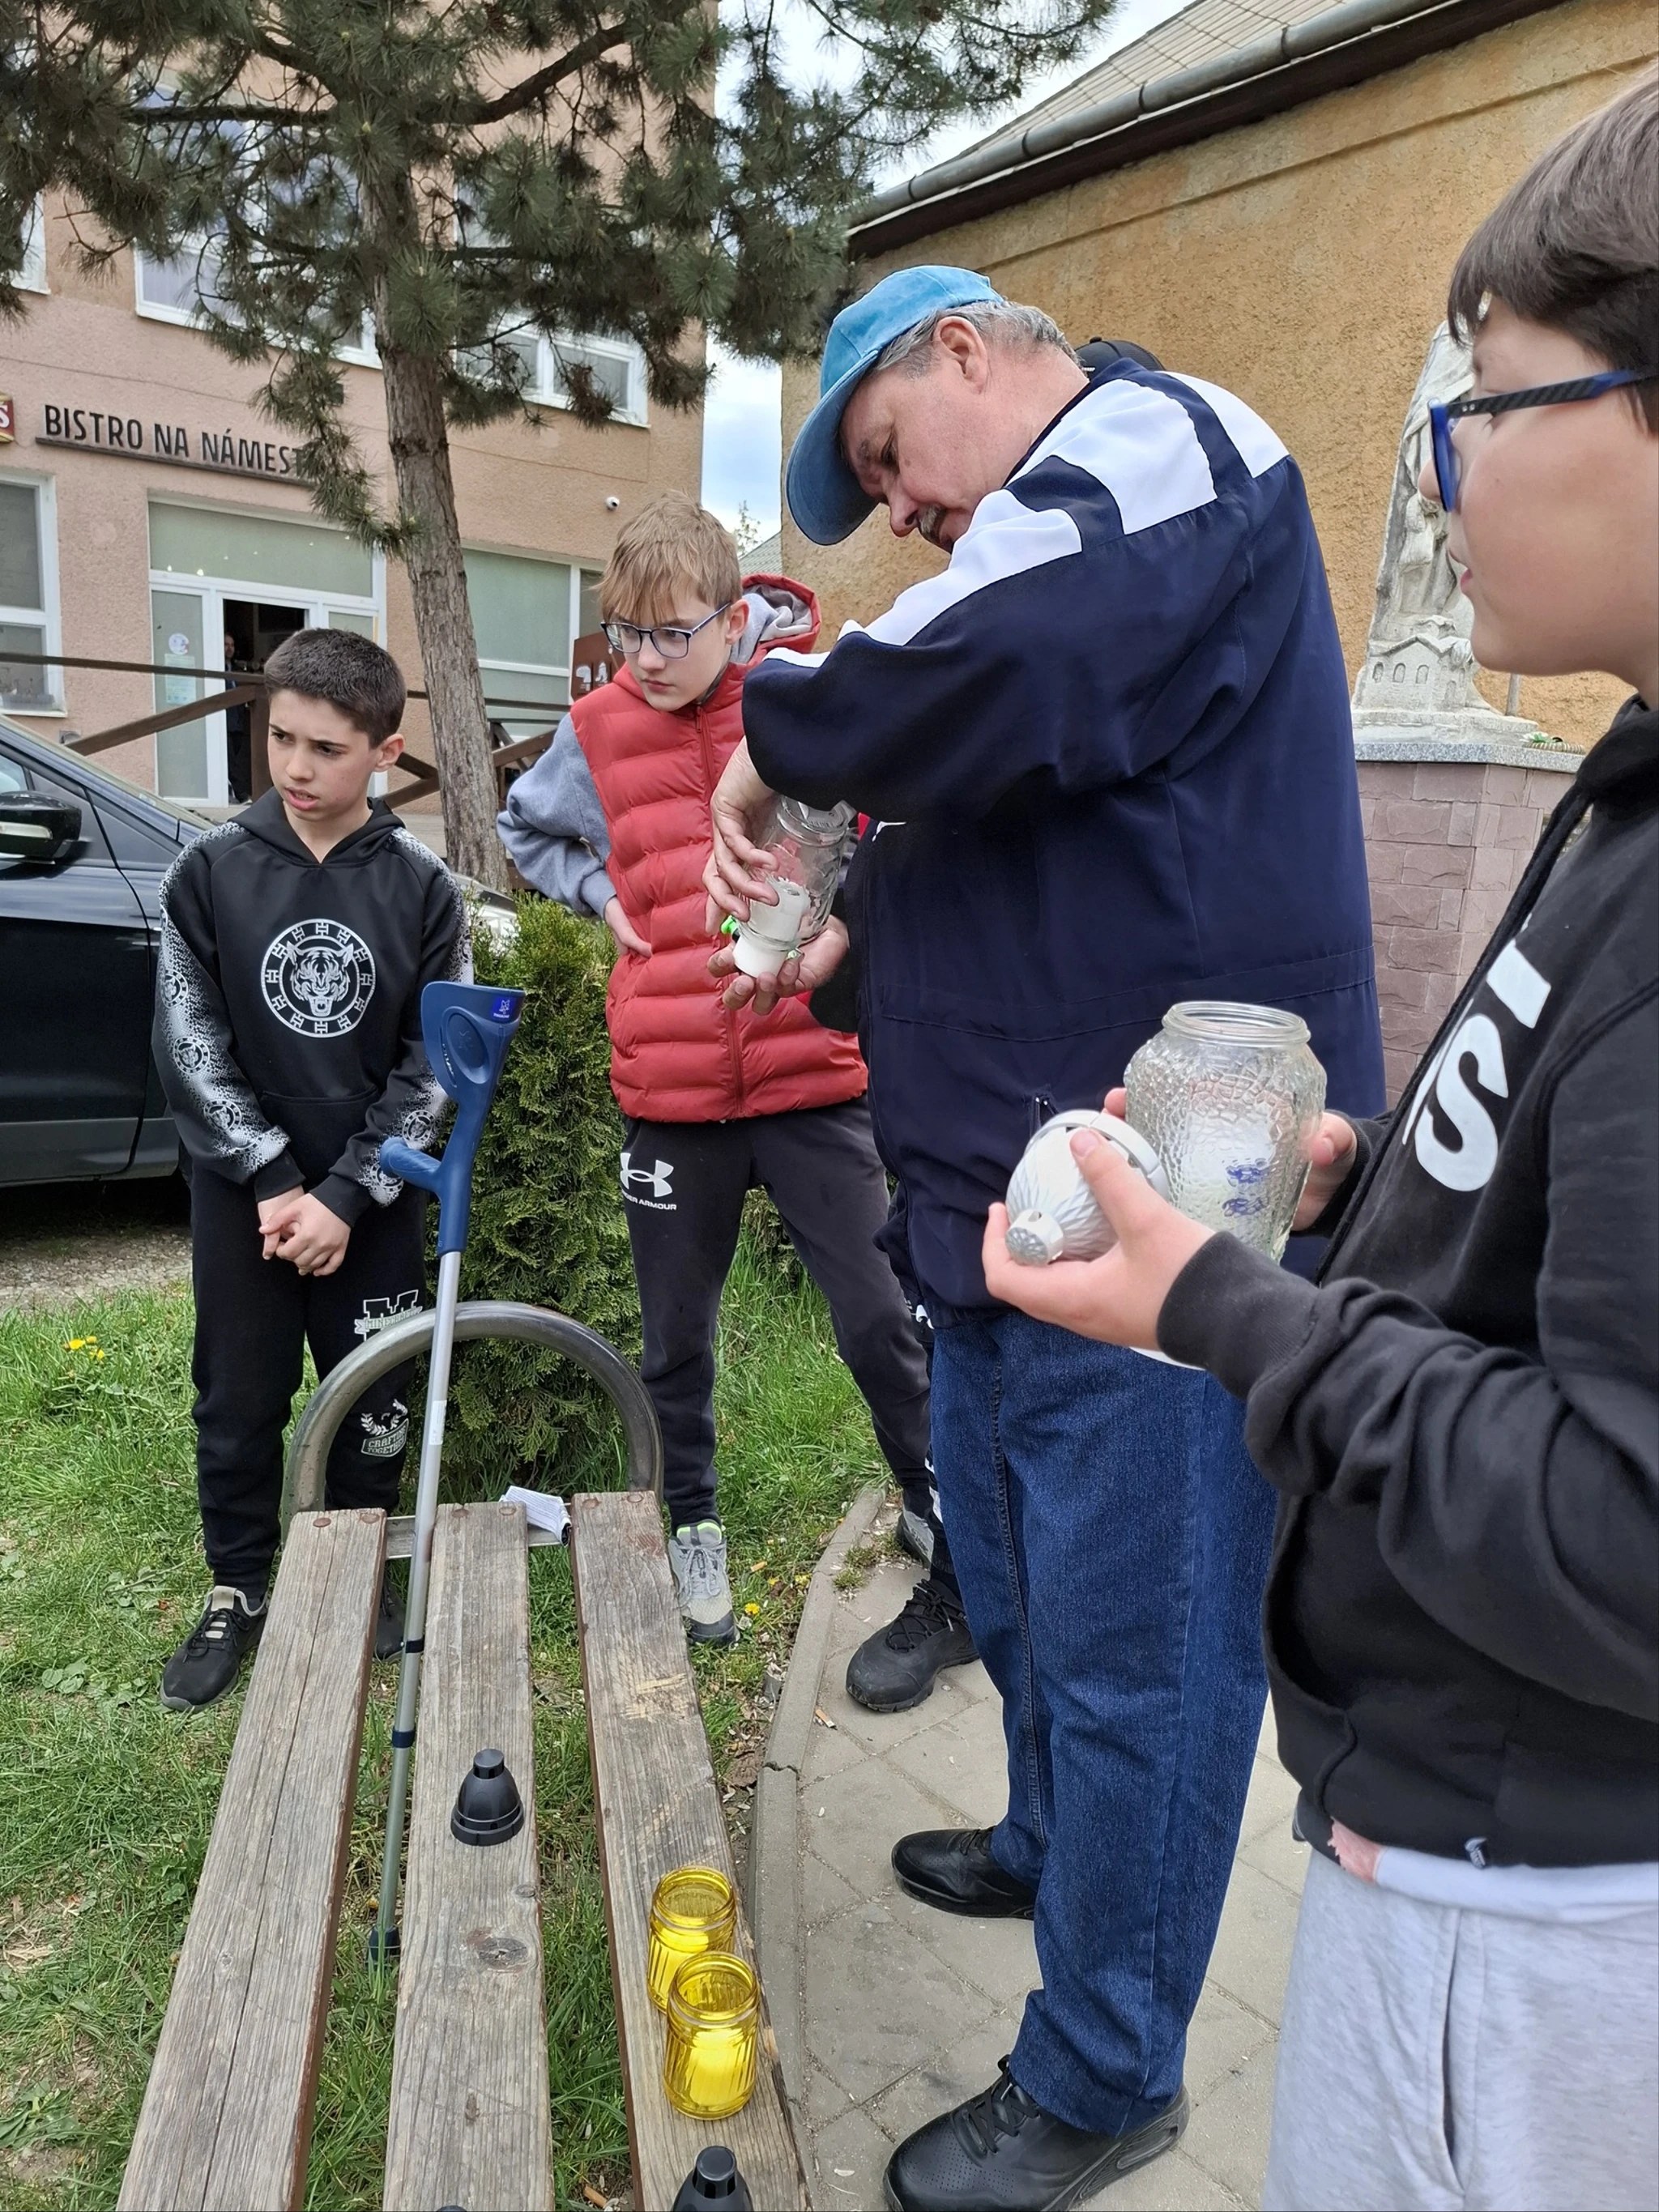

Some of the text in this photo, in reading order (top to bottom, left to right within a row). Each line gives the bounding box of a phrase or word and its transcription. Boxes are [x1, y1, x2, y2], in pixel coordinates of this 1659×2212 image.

[45, 405, 309, 477] BISTRO NA NÁMEST
[638, 1199, 677, 1211] ARMOUR
